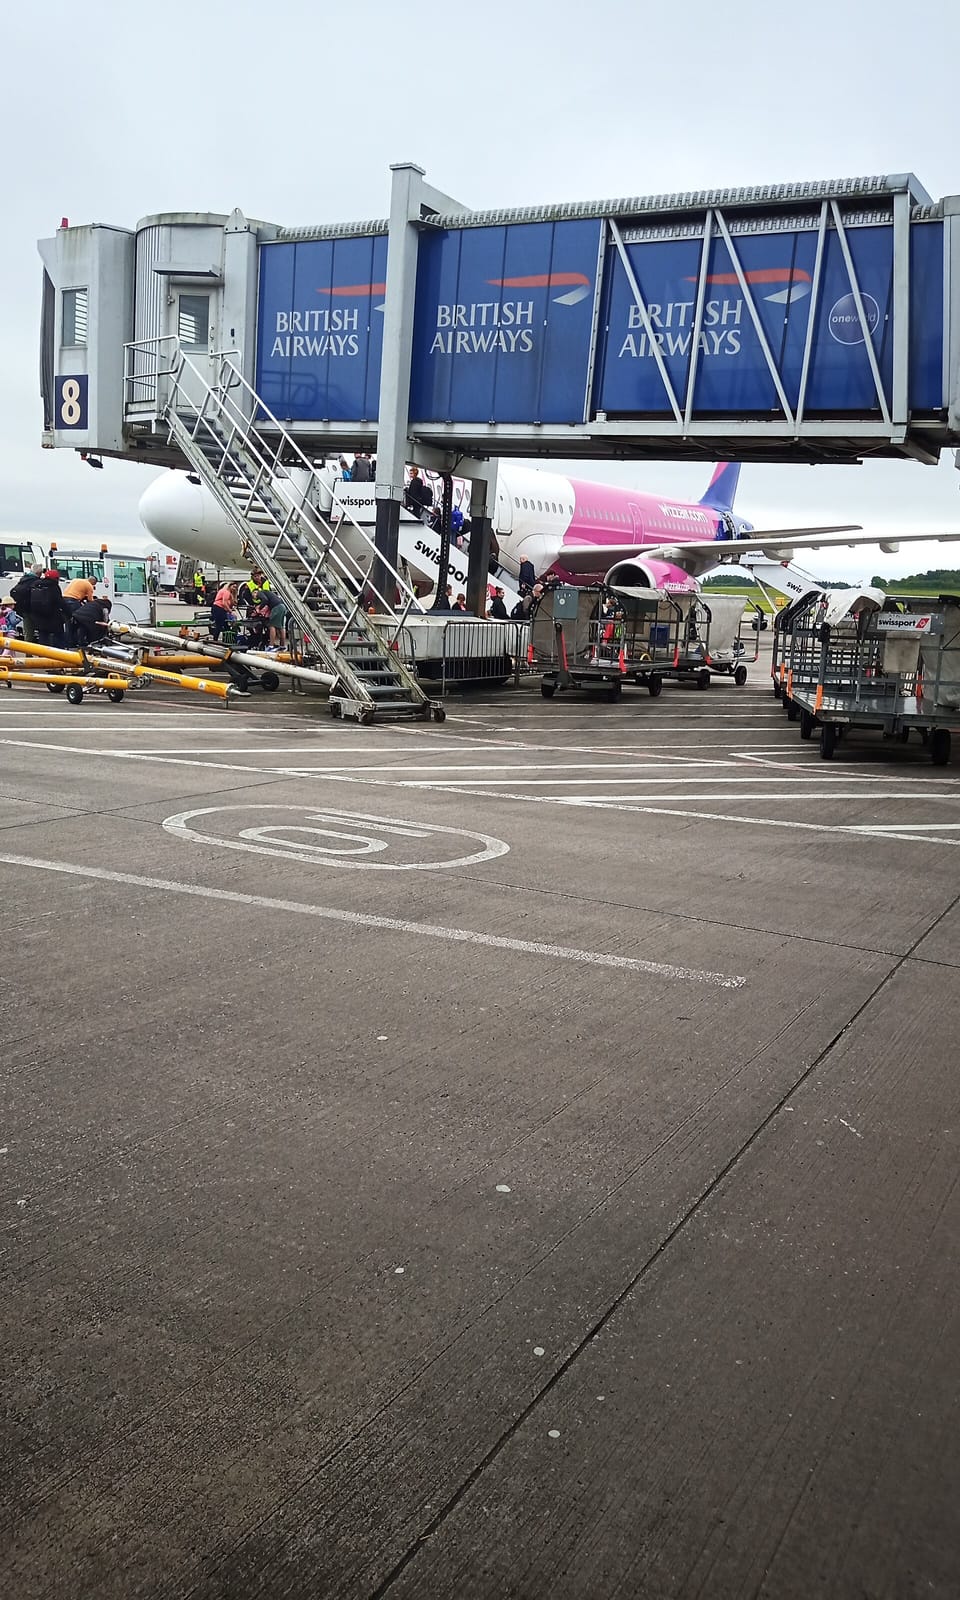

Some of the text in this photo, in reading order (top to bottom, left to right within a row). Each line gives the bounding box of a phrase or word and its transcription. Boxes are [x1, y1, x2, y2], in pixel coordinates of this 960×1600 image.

[276, 308, 358, 333] BRITISH
[436, 301, 534, 327] BRITISH
[628, 299, 743, 329] BRITSH
[271, 334, 359, 357] AIRWAYS
[430, 329, 533, 355] AIRWAYS
[61, 378, 81, 426] 8
[335, 495, 377, 509] wisspor
[878, 617, 917, 628] swissport
